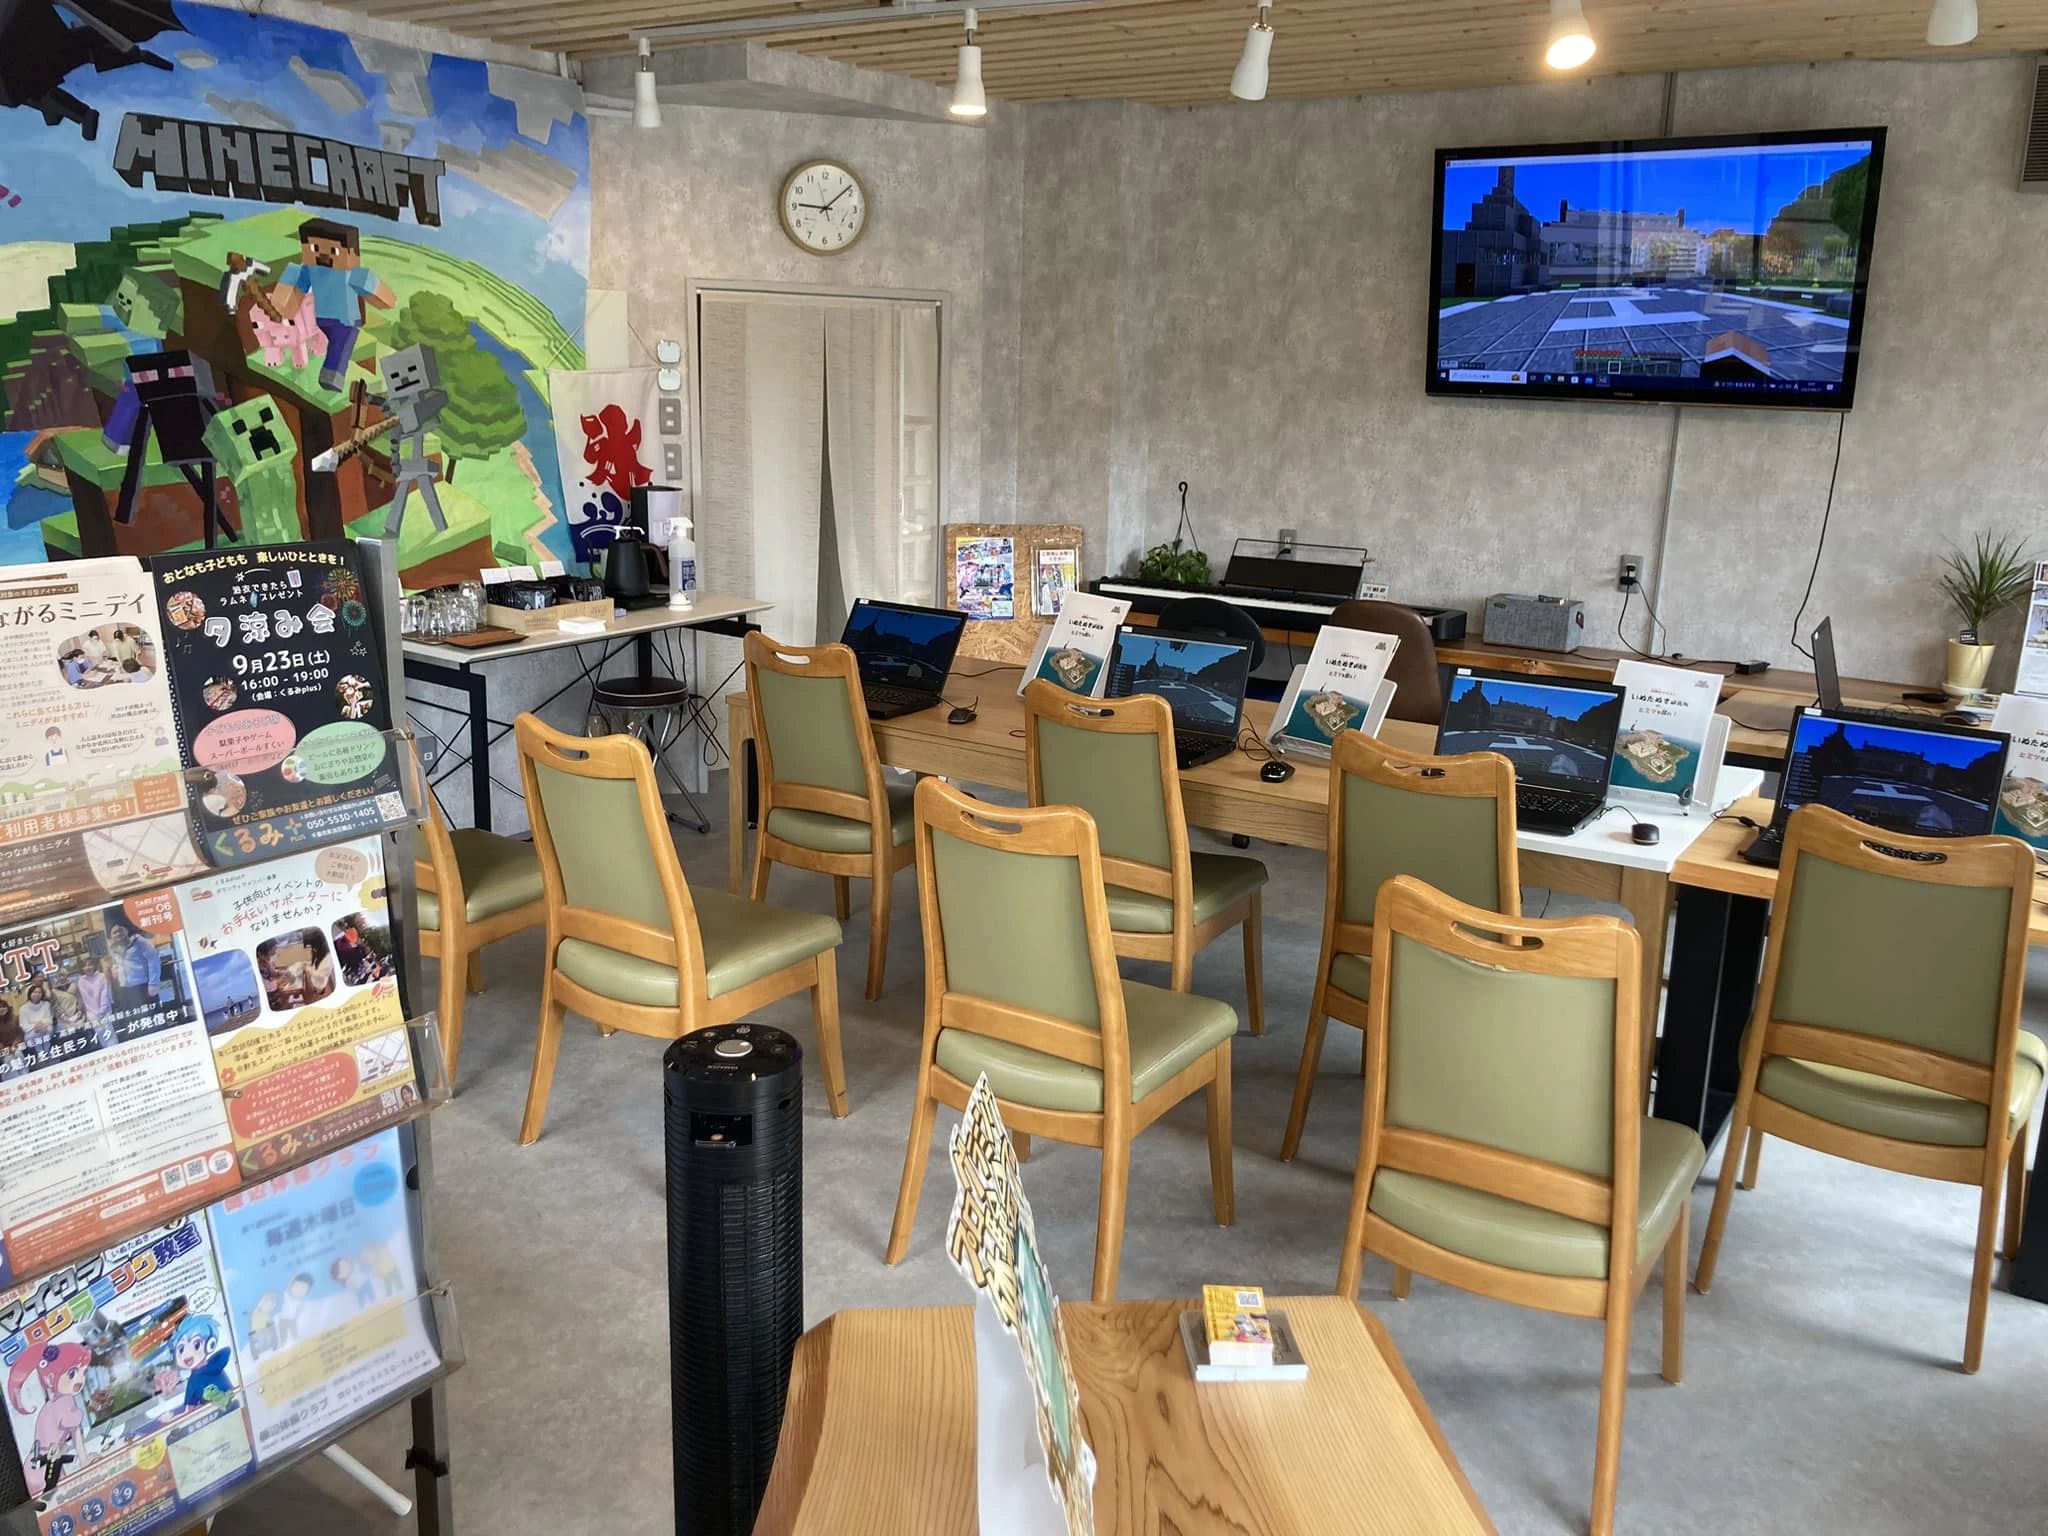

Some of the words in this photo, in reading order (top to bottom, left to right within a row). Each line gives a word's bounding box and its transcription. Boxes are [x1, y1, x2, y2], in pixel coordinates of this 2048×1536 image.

[113, 112, 446, 227] MINECRAFT
[163, 554, 248, 584] おとなも子どもも
[256, 551, 345, 566] 楽しいひとときを！
[220, 596, 248, 607] ラムネ
[204, 603, 337, 648] 夕涼み会
[241, 676, 279, 691] 16:00
[294, 667, 329, 683] 19:00
[210, 741, 285, 760] スーパーボールすくい
[218, 731, 273, 748] 駄菓子やゲーム
[6, 800, 132, 839] 利用者様募集中！
[307, 807, 376, 830] 050-5530-1405
[214, 823, 285, 857] くるみ
[232, 880, 324, 911] 子供向けイベントの
[221, 891, 343, 934] お手伝いサポーターに
[250, 904, 323, 932] なりませんか？
[241, 1133, 303, 1171] くるみ
[111, 1234, 150, 1257] いぬたぬき
[0, 1252, 105, 1332] マイクラ
[0, 1221, 202, 1367] プログラミング教室
[113, 1485, 132, 1501] 9/9
[82, 1503, 103, 1518] 9/3
[52, 1519, 72, 1534] 9/2
